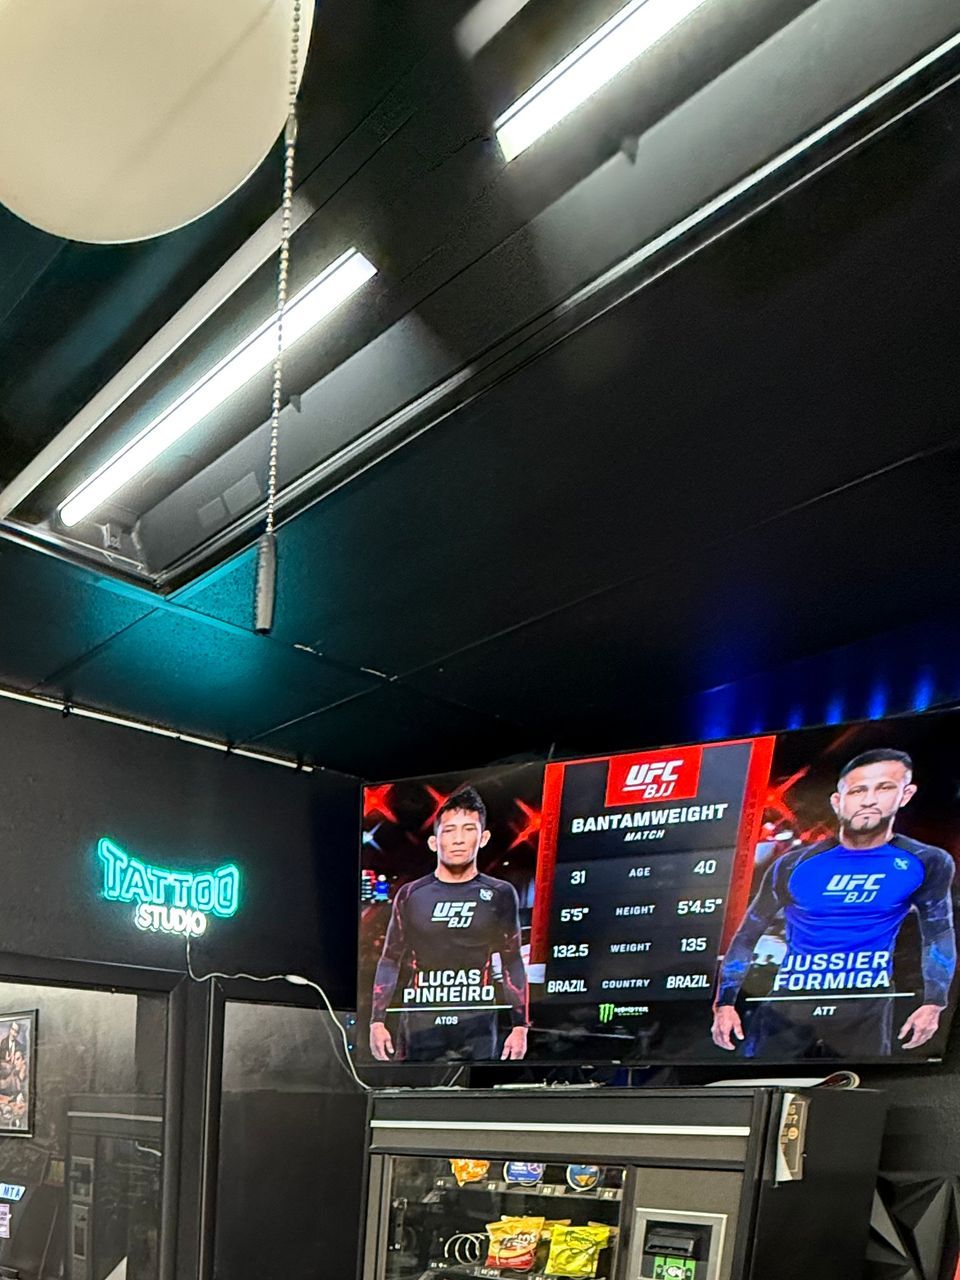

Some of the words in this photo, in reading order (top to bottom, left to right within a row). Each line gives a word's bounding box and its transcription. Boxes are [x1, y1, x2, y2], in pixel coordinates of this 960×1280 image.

[626, 760, 684, 785] UFC
[643, 782, 676, 798] BJJ
[571, 803, 728, 833] BANTAMWEIGHT
[624, 829, 665, 841] MATCH
[98, 838, 239, 917] TATTOO
[570, 870, 586, 885] 31
[629, 867, 651, 878] AGE
[694, 860, 717, 874] 40
[826, 874, 886, 890] UFC
[843, 891, 877, 903] BJJ
[433, 902, 477, 917] UFC
[615, 905, 655, 916] HEIGHT
[136, 904, 207, 936] STUDIO
[448, 917, 472, 928] BJJ
[553, 944, 589, 958] 132.5
[610, 942, 652, 953] WEIGHT
[680, 937, 707, 951] 135
[781, 951, 889, 972] JUSSIER
[418, 969, 481, 987] LUCAS
[547, 979, 587, 993] BRAZIL
[602, 978, 651, 989] COUNTRY
[666, 974, 711, 989] BRAZIL
[773, 970, 890, 991] FORMIGA
[403, 985, 494, 1003] PINHEIRO
[813, 1006, 837, 1016] ATT
[434, 1016, 459, 1025] ATOS
